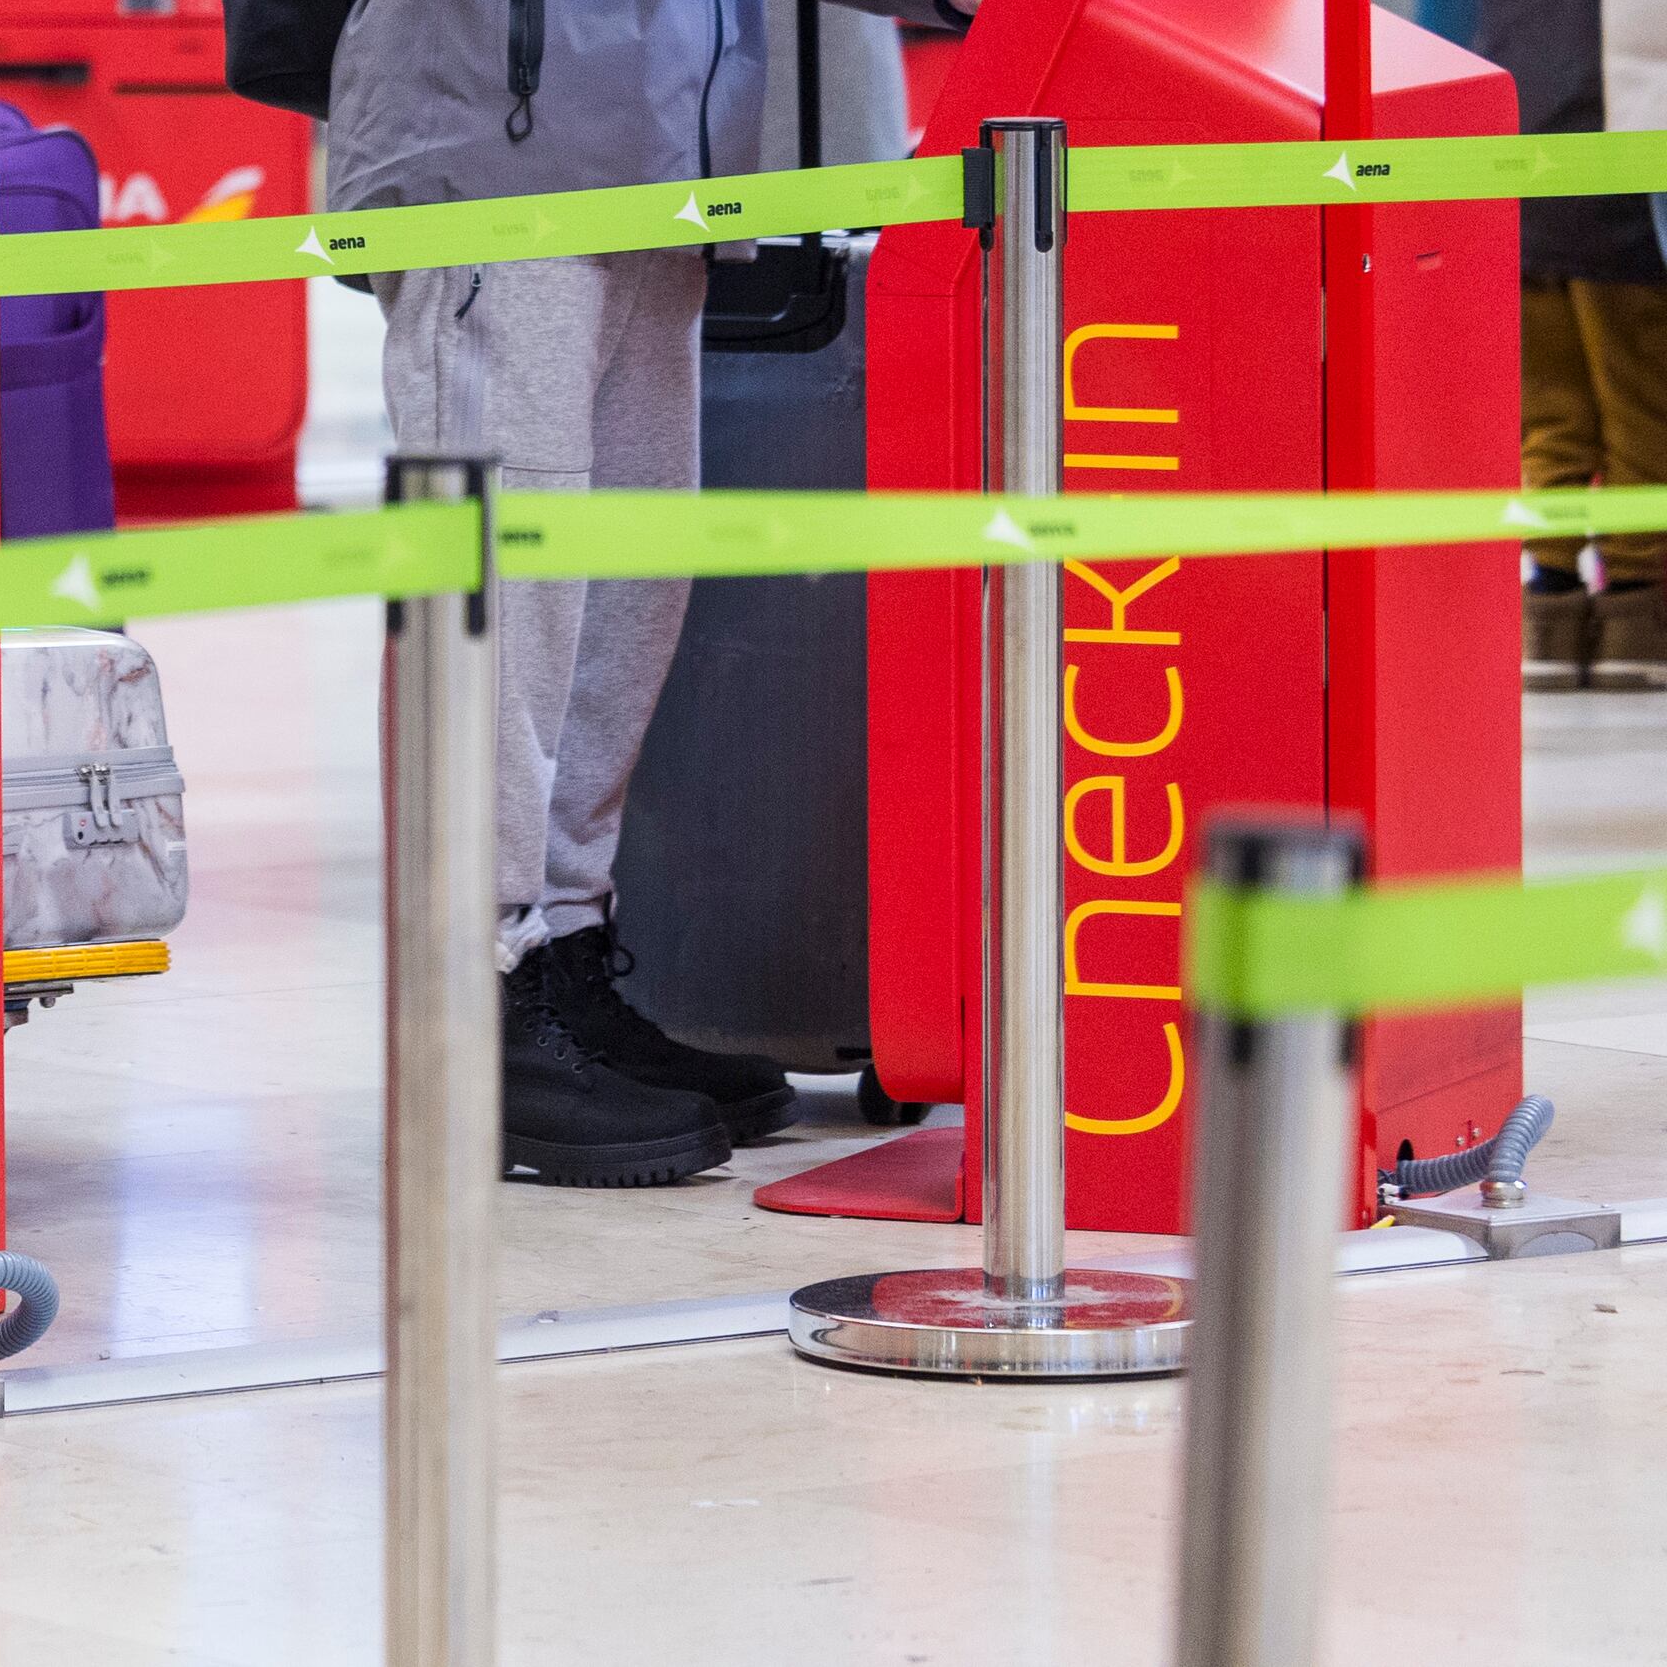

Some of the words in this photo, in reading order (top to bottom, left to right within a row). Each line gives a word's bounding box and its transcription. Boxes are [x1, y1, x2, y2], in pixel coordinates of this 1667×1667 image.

[1356, 163, 1391, 177] aena
[707, 201, 743, 217] aena
[329, 236, 366, 251] aena
